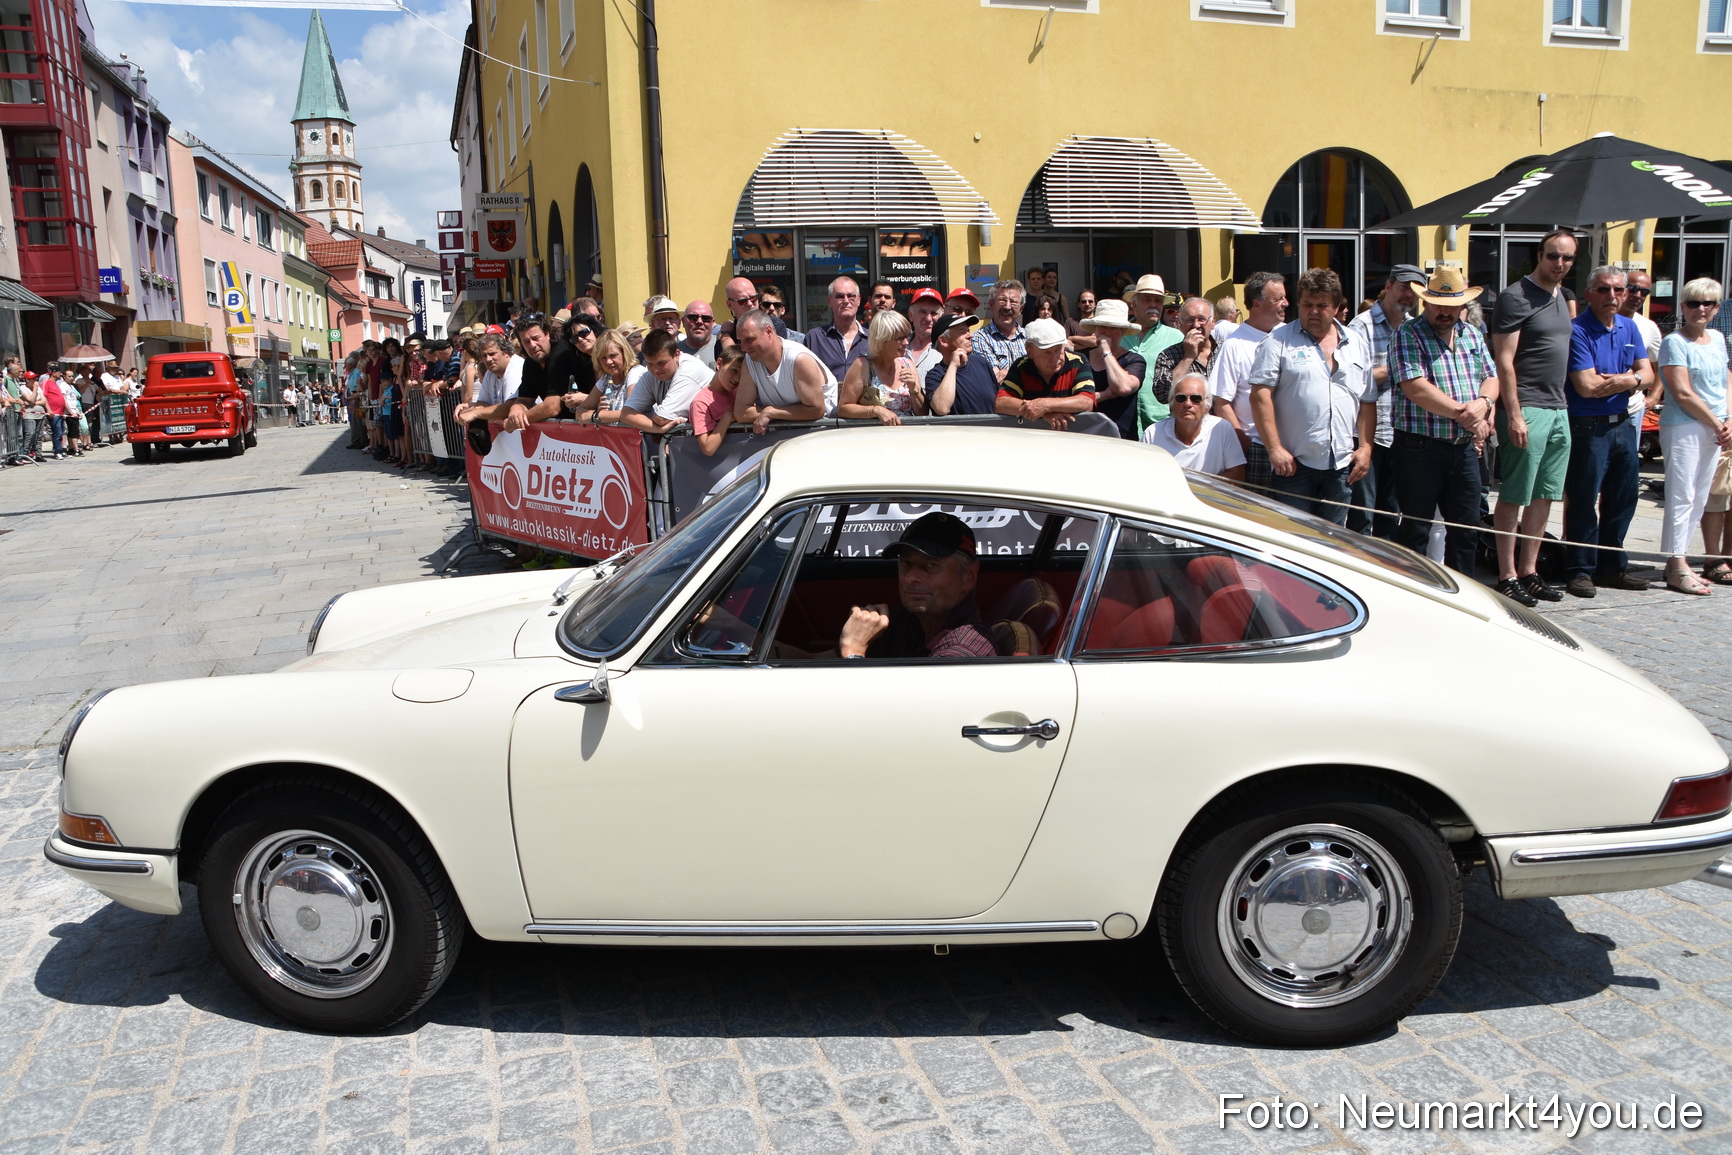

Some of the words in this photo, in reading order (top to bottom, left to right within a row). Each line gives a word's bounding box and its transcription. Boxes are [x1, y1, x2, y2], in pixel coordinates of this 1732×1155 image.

[480, 197, 513, 205] RATHAUS
[892, 262, 927, 270] Passbilder
[467, 280, 490, 288] SARAH
[490, 279, 496, 287] K
[227, 293, 240, 306] B
[150, 406, 208, 416] CHEVROLET
[539, 447, 596, 466] Autoklassik
[527, 464, 594, 504] Dietz
[525, 500, 562, 514] BREITENBRUNN
[486, 512, 636, 556] www.autoklassik-dietz.de
